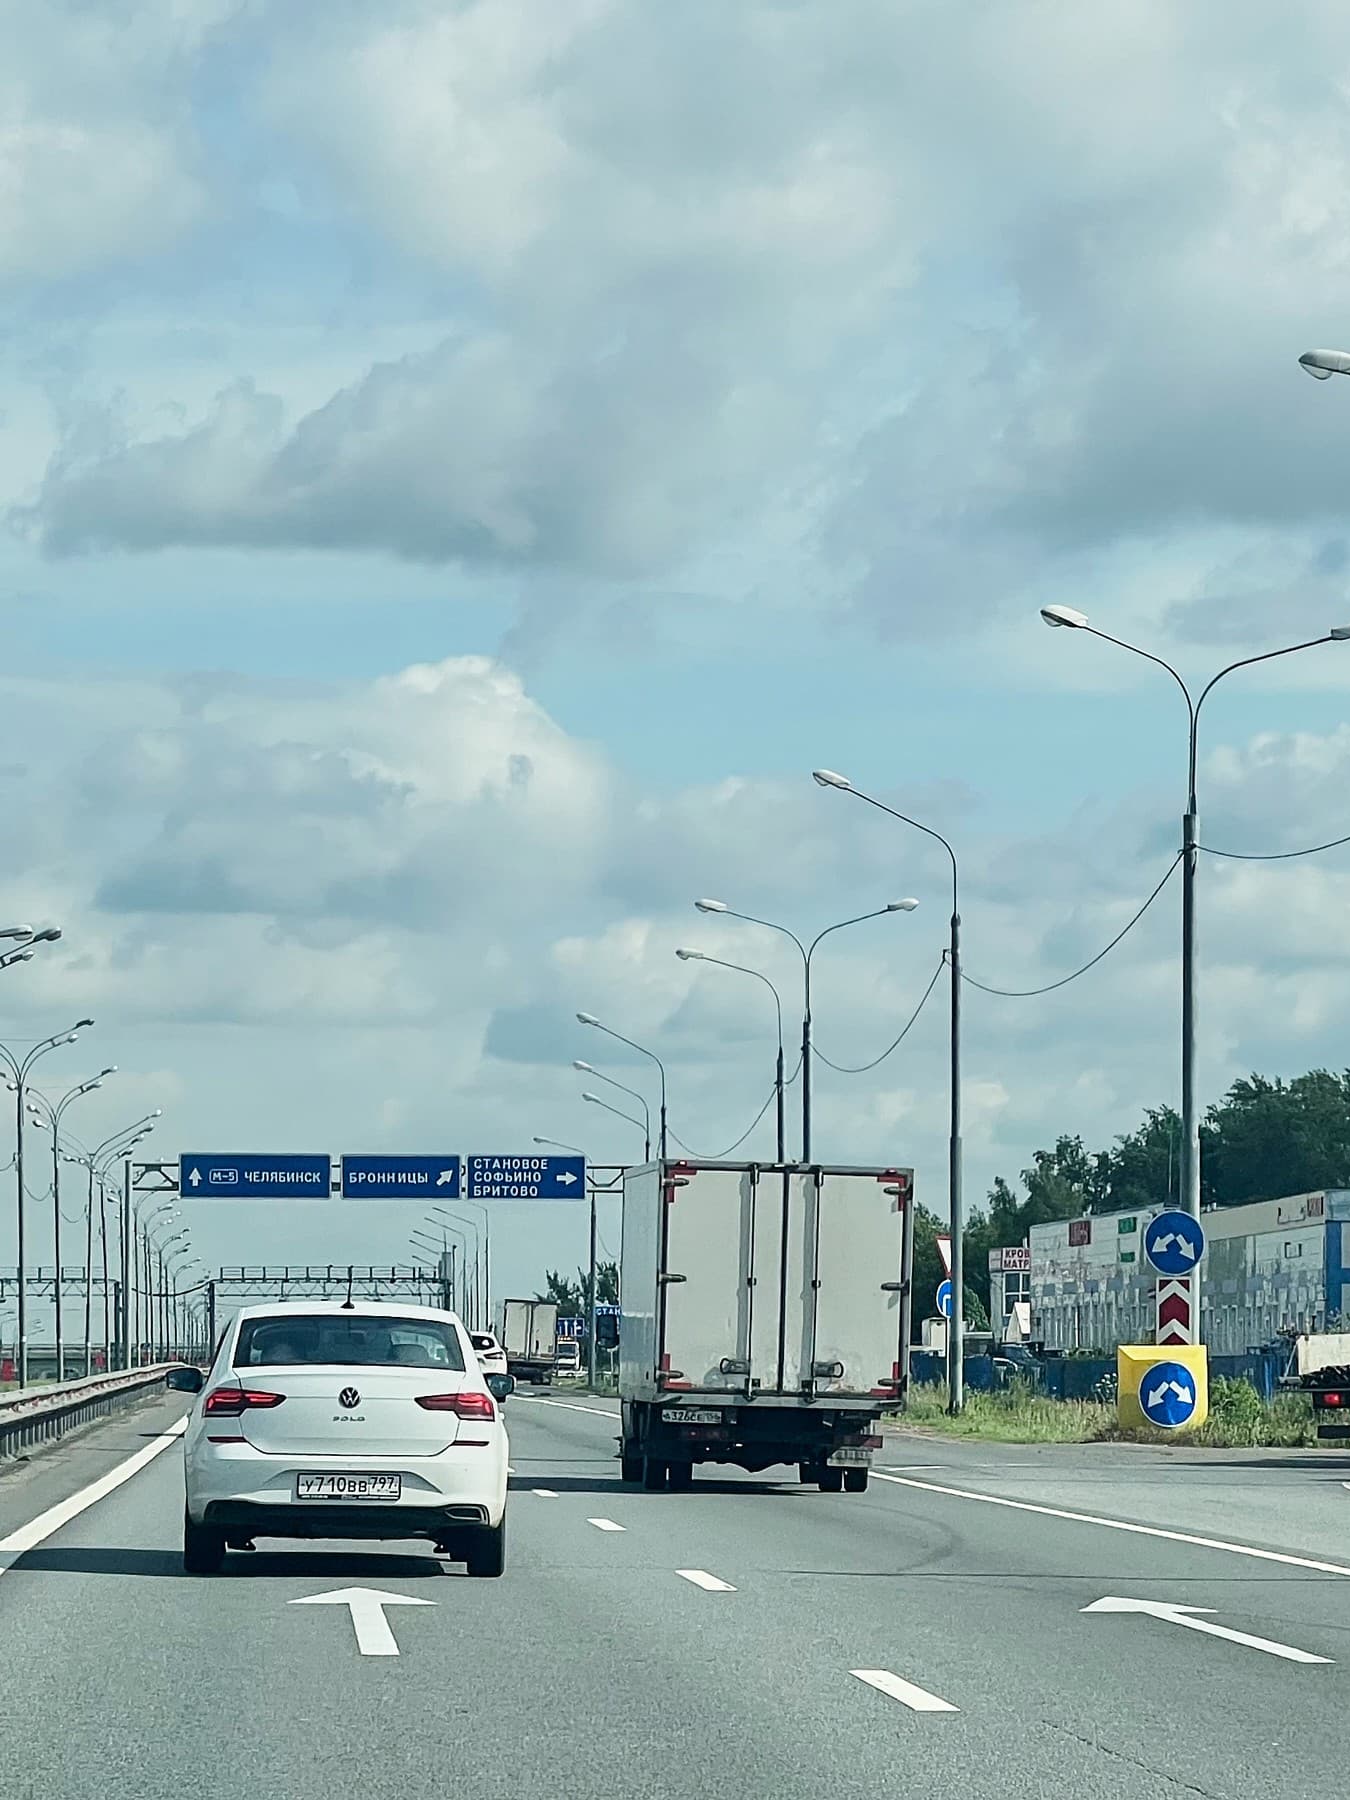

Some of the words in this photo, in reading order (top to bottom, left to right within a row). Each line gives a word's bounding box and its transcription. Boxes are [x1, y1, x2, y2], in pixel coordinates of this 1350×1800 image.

[473, 1158, 548, 1170] СТАНОВОЕ
[244, 1171, 321, 1183] ЧЕЛЯБИНСК
[349, 1172, 428, 1184] БРОННИЦЫ
[473, 1172, 542, 1183] СОФЬИНО
[473, 1186, 538, 1197] БРИТОВО
